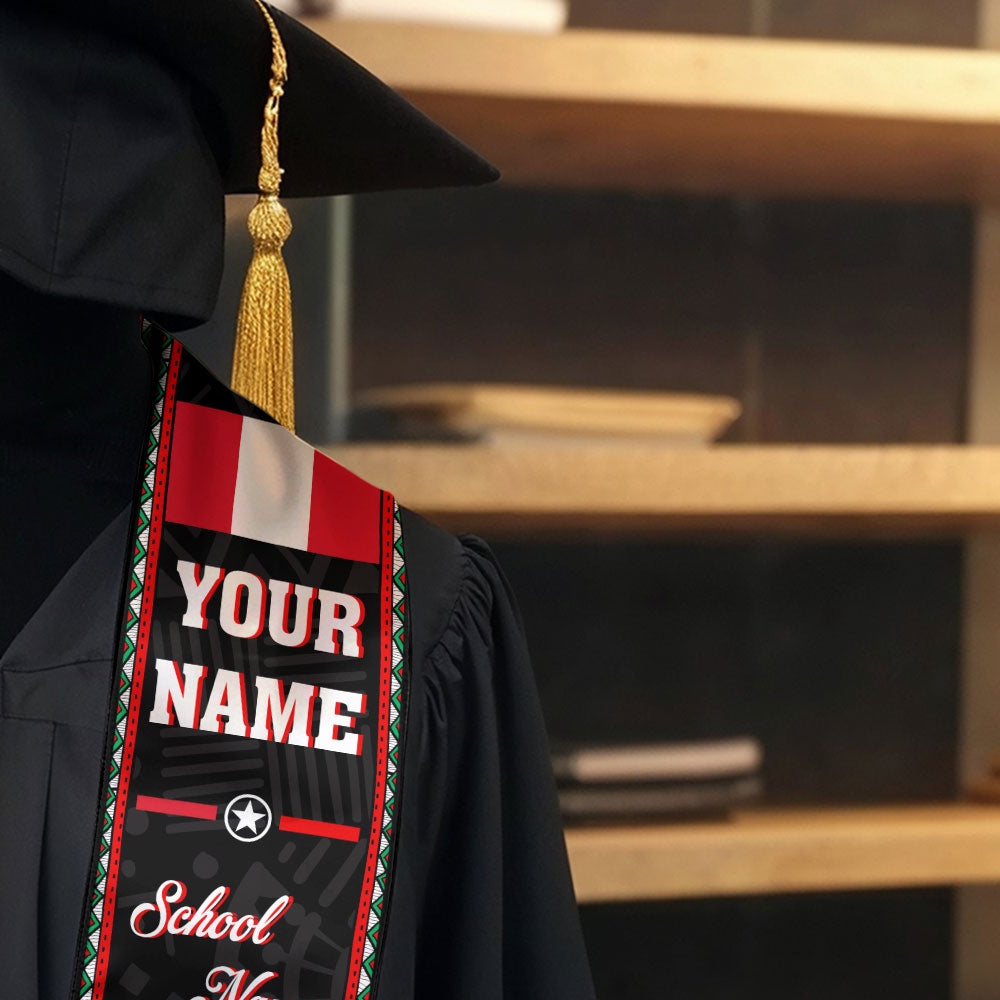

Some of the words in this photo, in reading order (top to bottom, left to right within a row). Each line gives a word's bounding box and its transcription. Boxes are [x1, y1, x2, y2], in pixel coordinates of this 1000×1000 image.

[176, 560, 367, 658] YOUR
[149, 658, 367, 756] NAME
[130, 879, 294, 945] School
